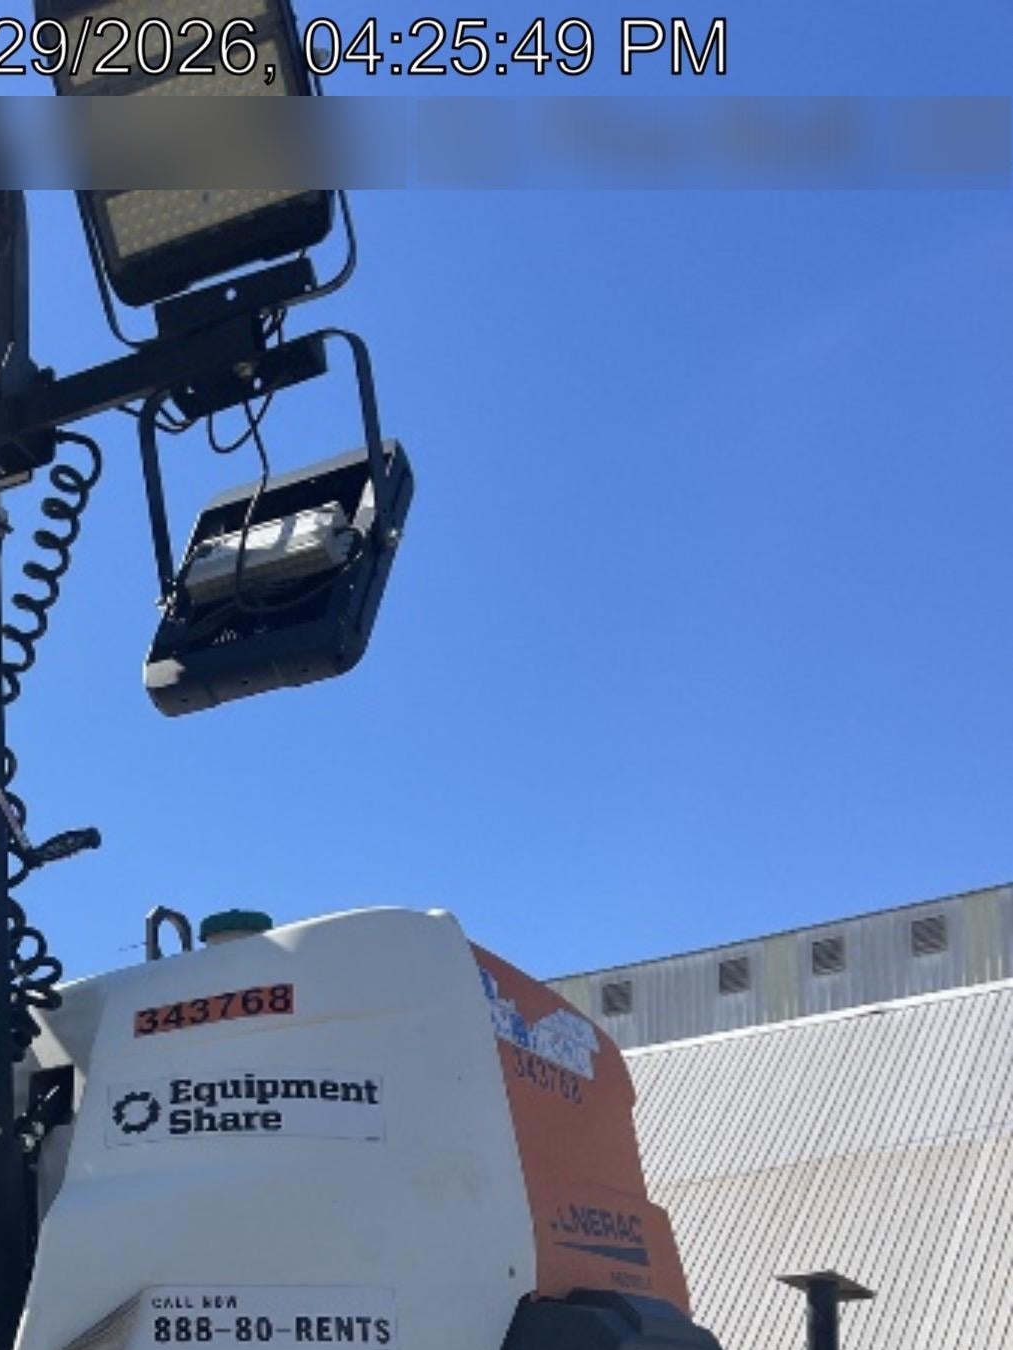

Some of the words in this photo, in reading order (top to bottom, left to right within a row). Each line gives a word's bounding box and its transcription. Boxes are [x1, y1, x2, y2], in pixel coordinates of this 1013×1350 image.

[136, 983, 292, 1036] 343768
[169, 1072, 380, 1108] Equipment
[169, 1106, 283, 1136] Share
[151, 1295, 194, 1310] CALL
[154, 1315, 392, 1345] 888-80-RENTS
